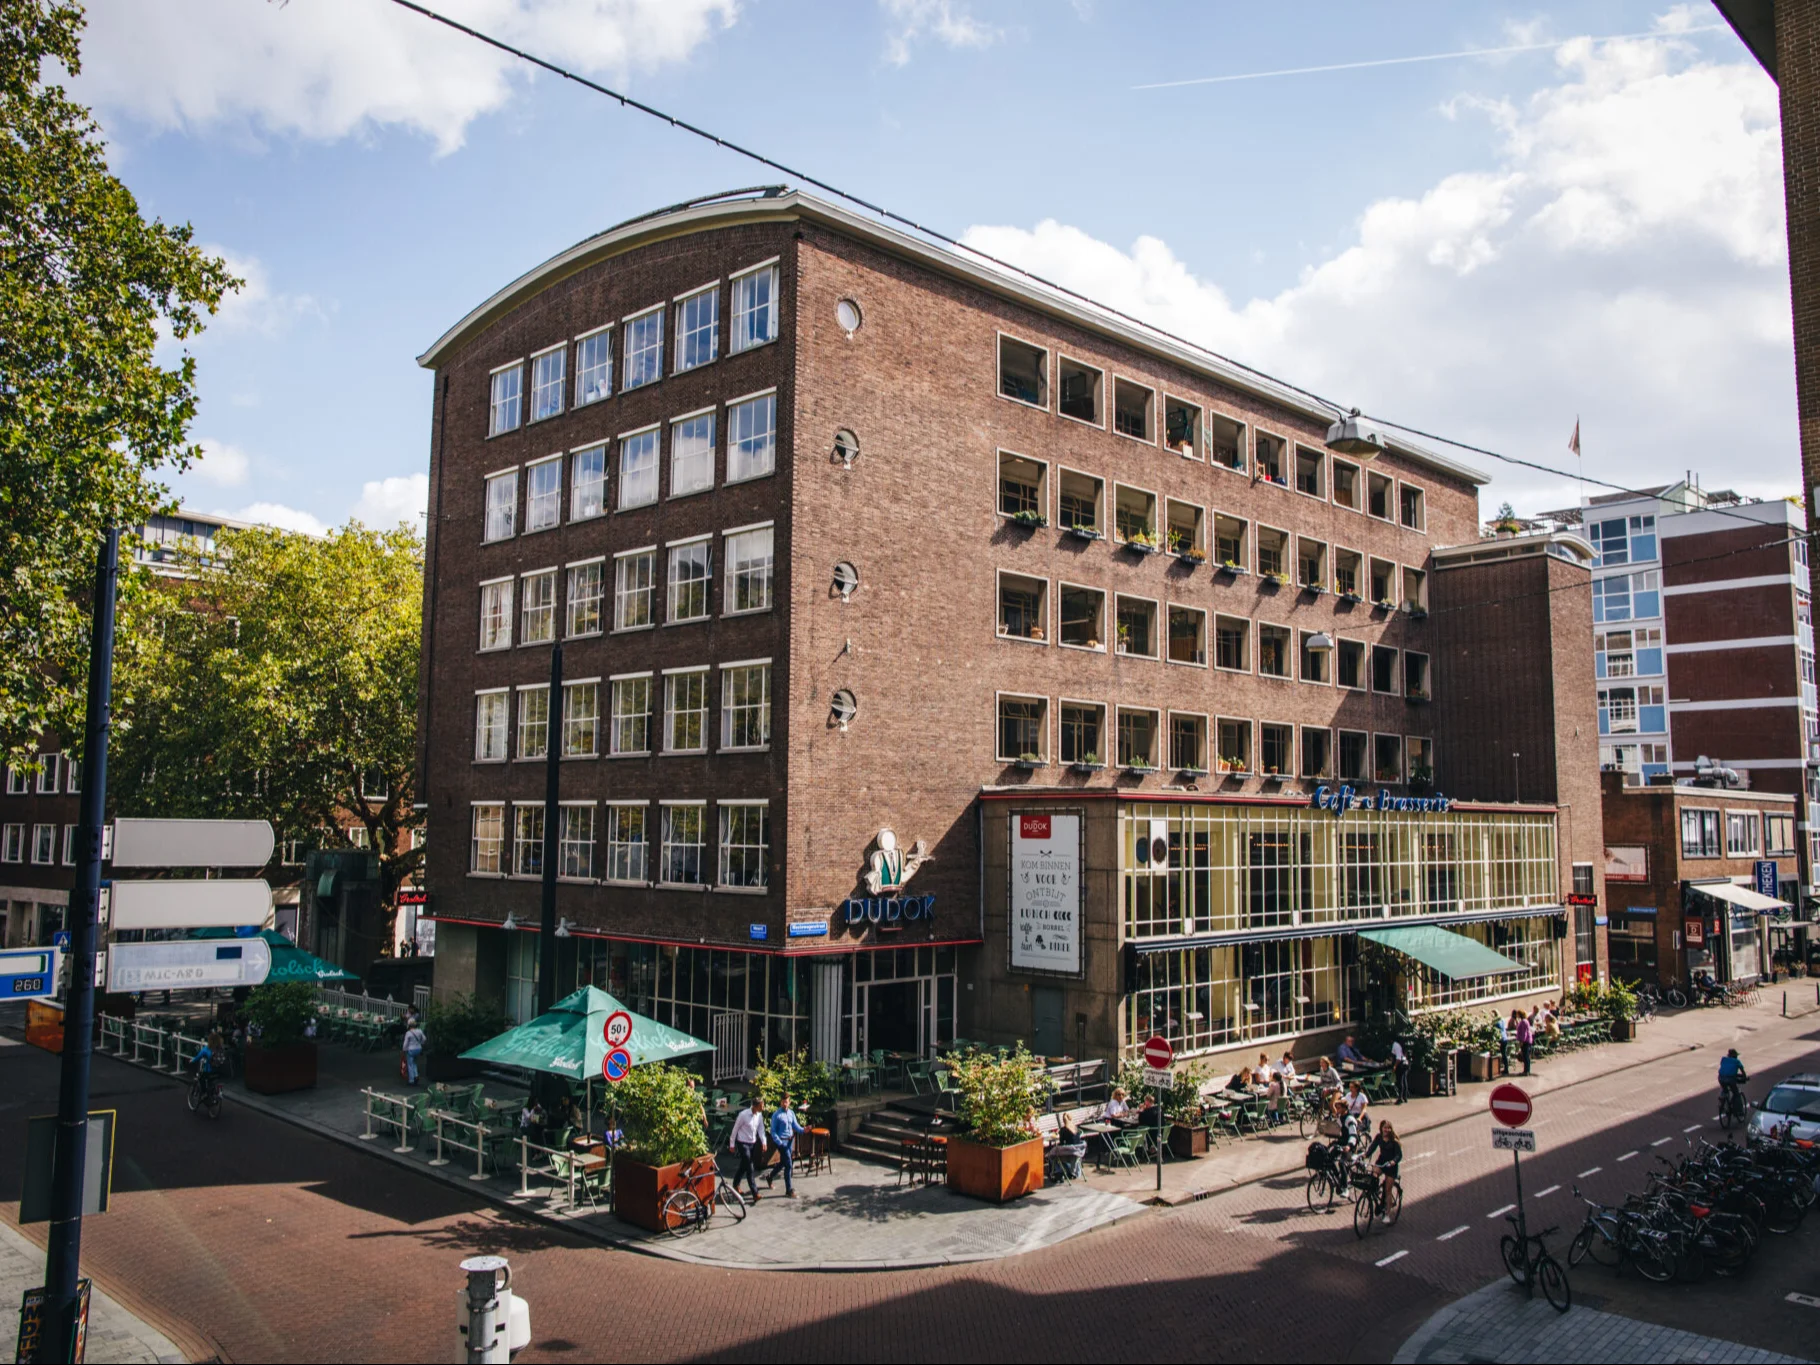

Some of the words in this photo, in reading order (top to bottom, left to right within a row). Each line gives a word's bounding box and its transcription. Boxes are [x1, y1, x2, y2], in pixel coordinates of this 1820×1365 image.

[1314, 784, 1355, 817] Café
[1378, 788, 1450, 813] Brasserie
[1023, 822, 1047, 830] DUDOK
[1020, 860, 1038, 869] KOM
[1040, 861, 1071, 871] BINNEN
[1026, 887, 1067, 902] ONTBIJT
[847, 896, 936, 924] DUDOK
[1020, 908, 1051, 919] LUNCH
[15, 978, 41, 992] 260
[610, 1024, 622, 1035] 50
[622, 1025, 627, 1034] t
[1492, 1129, 1534, 1138] uitgezonderd
